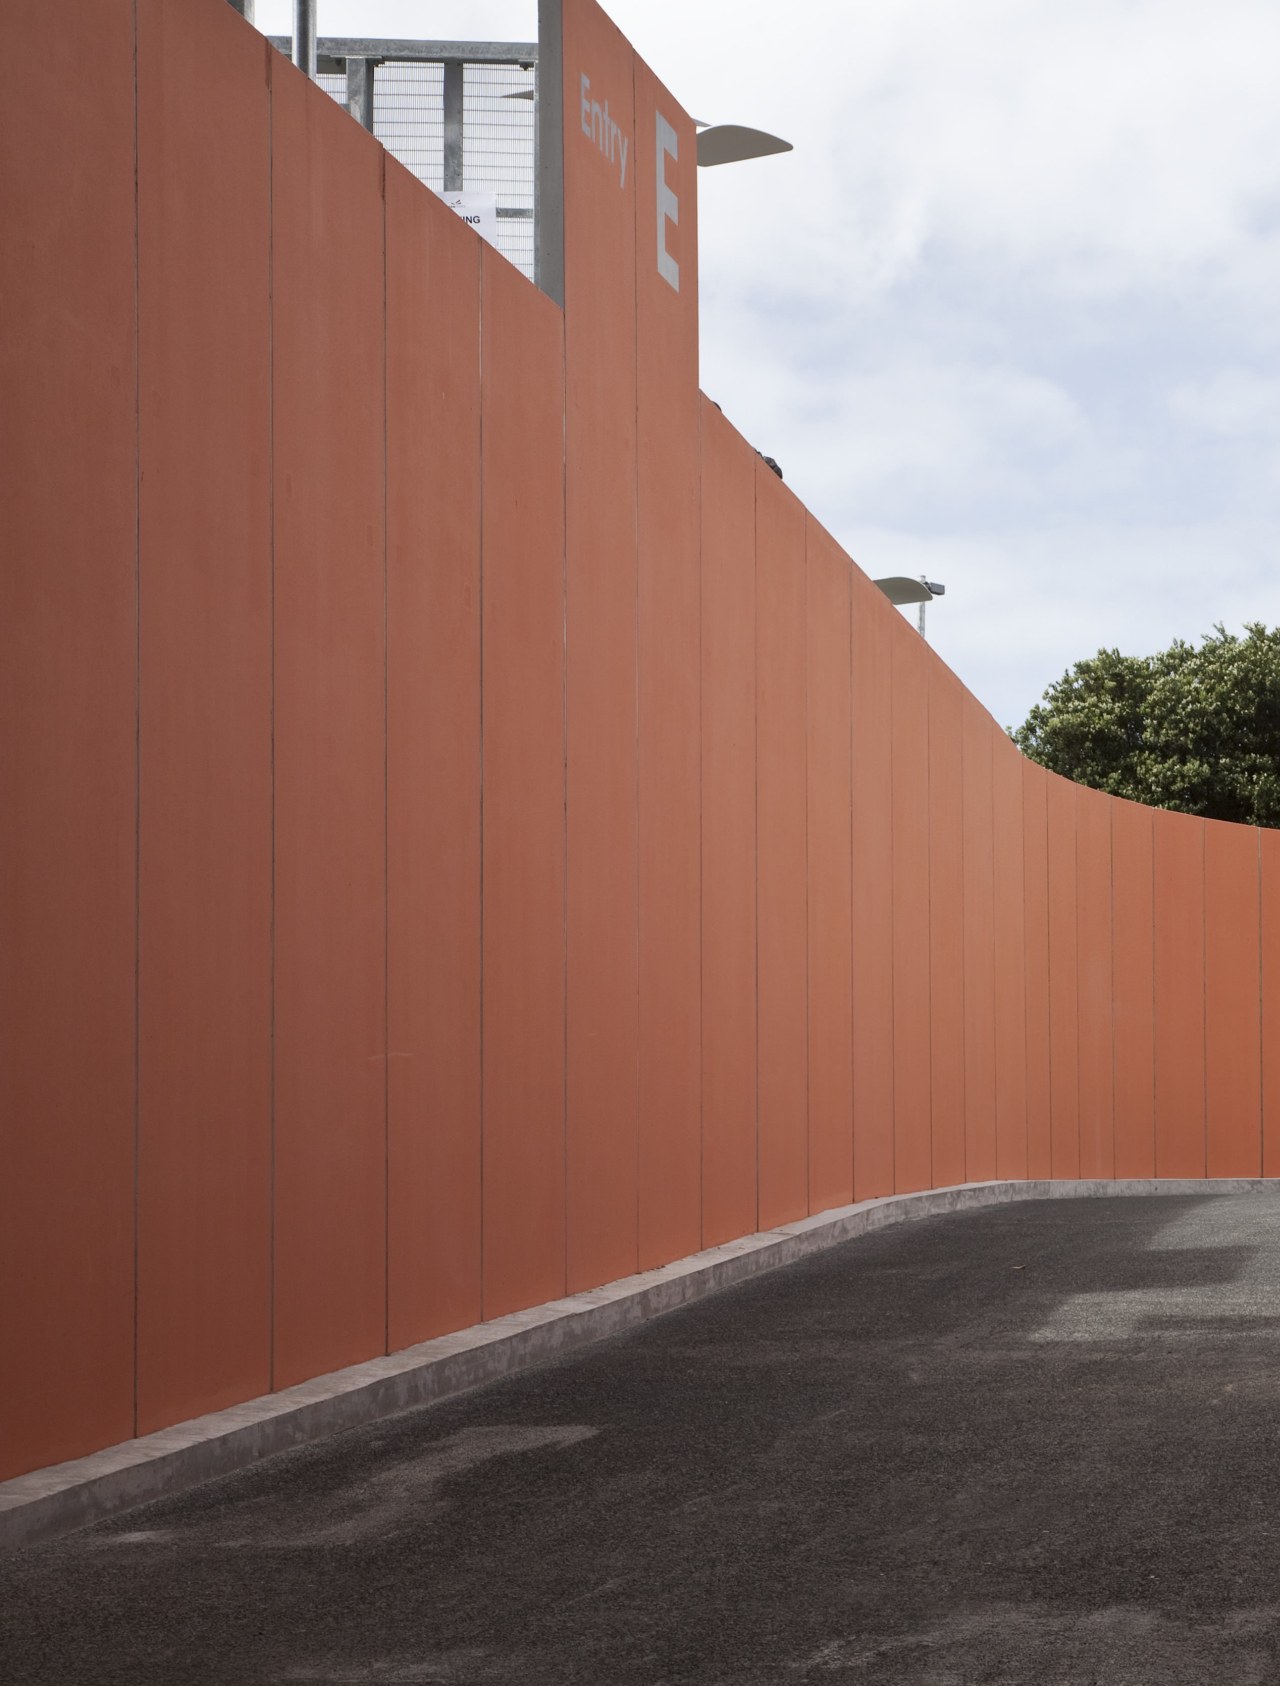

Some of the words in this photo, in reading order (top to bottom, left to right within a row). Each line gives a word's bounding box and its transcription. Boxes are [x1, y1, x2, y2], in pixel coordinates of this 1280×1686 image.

[580, 71, 629, 190] Entry
[460, 215, 481, 225] ING
[655, 109, 680, 294] E
